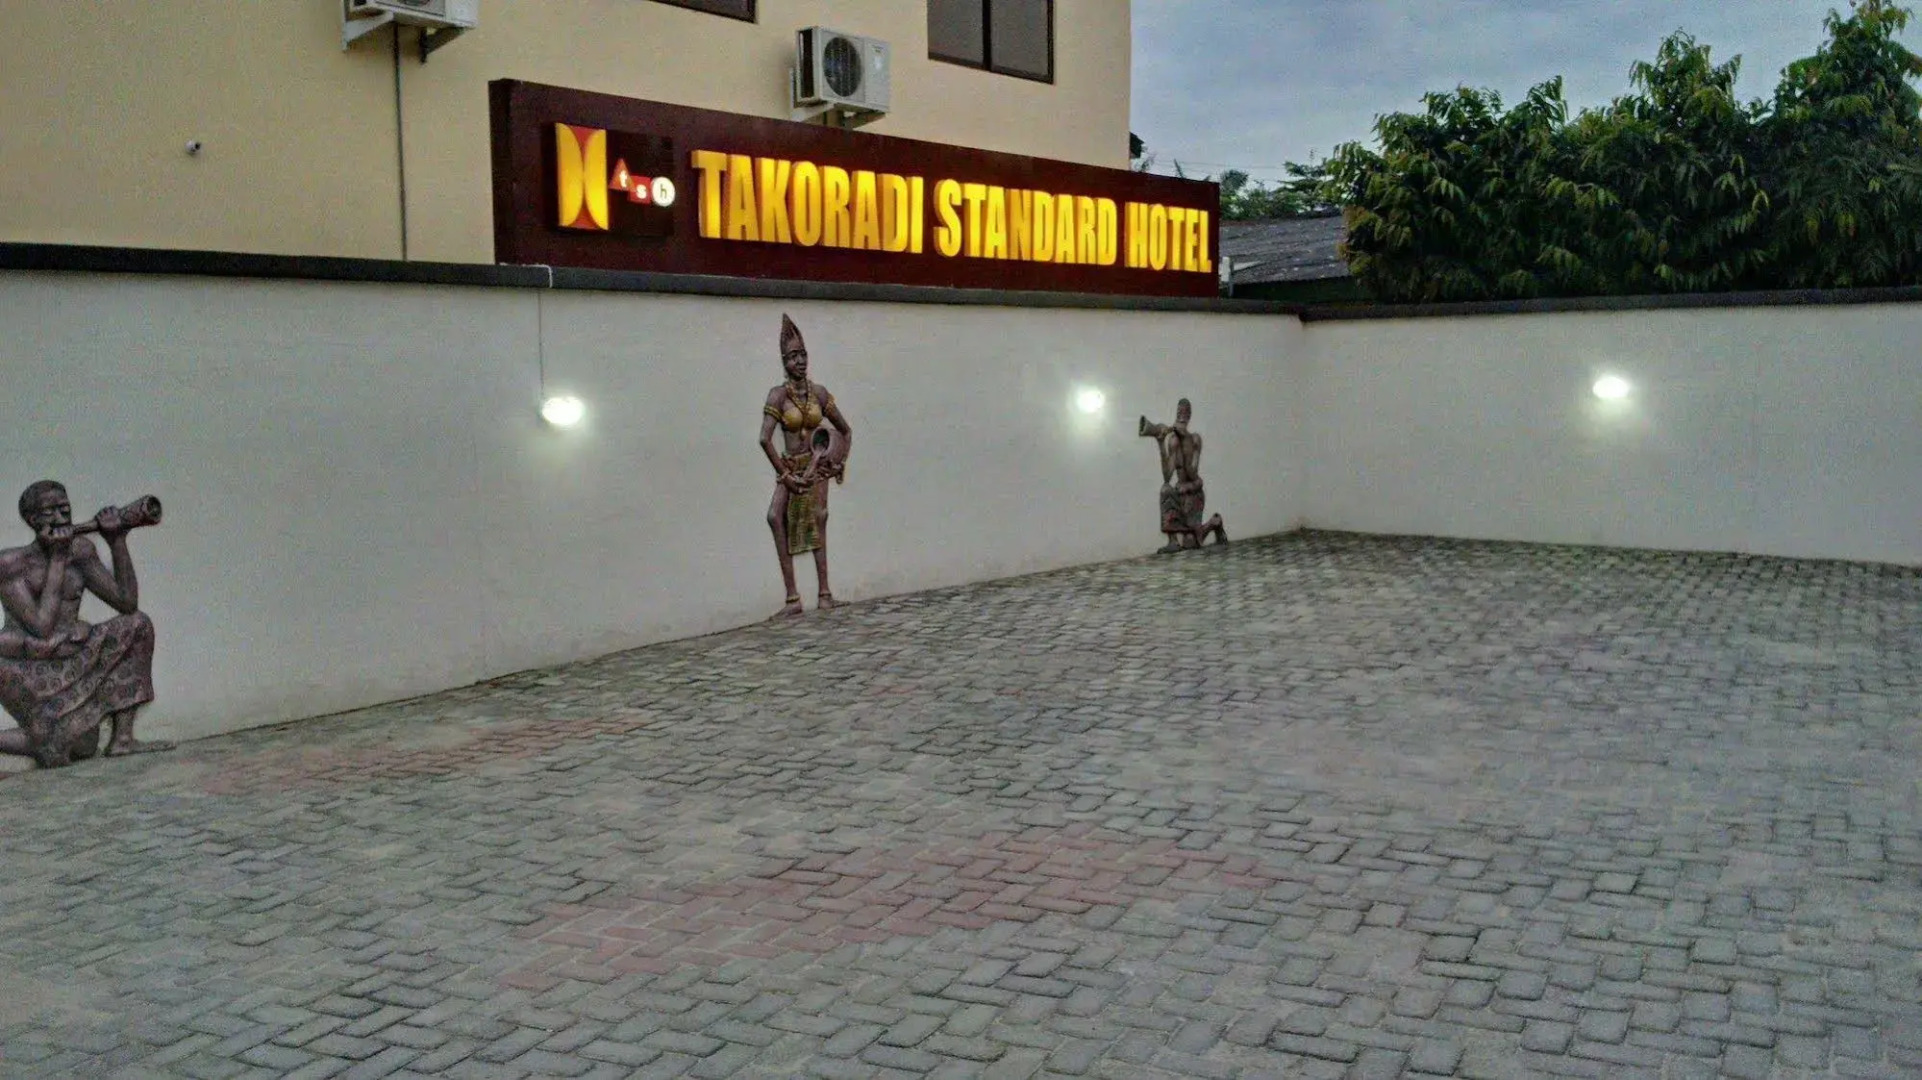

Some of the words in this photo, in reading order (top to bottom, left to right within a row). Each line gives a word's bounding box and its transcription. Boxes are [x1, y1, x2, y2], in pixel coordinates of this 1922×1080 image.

[691, 150, 924, 254] TAKORADI
[933, 179, 1117, 266] STANDARD
[1124, 201, 1213, 274] HOTEL
